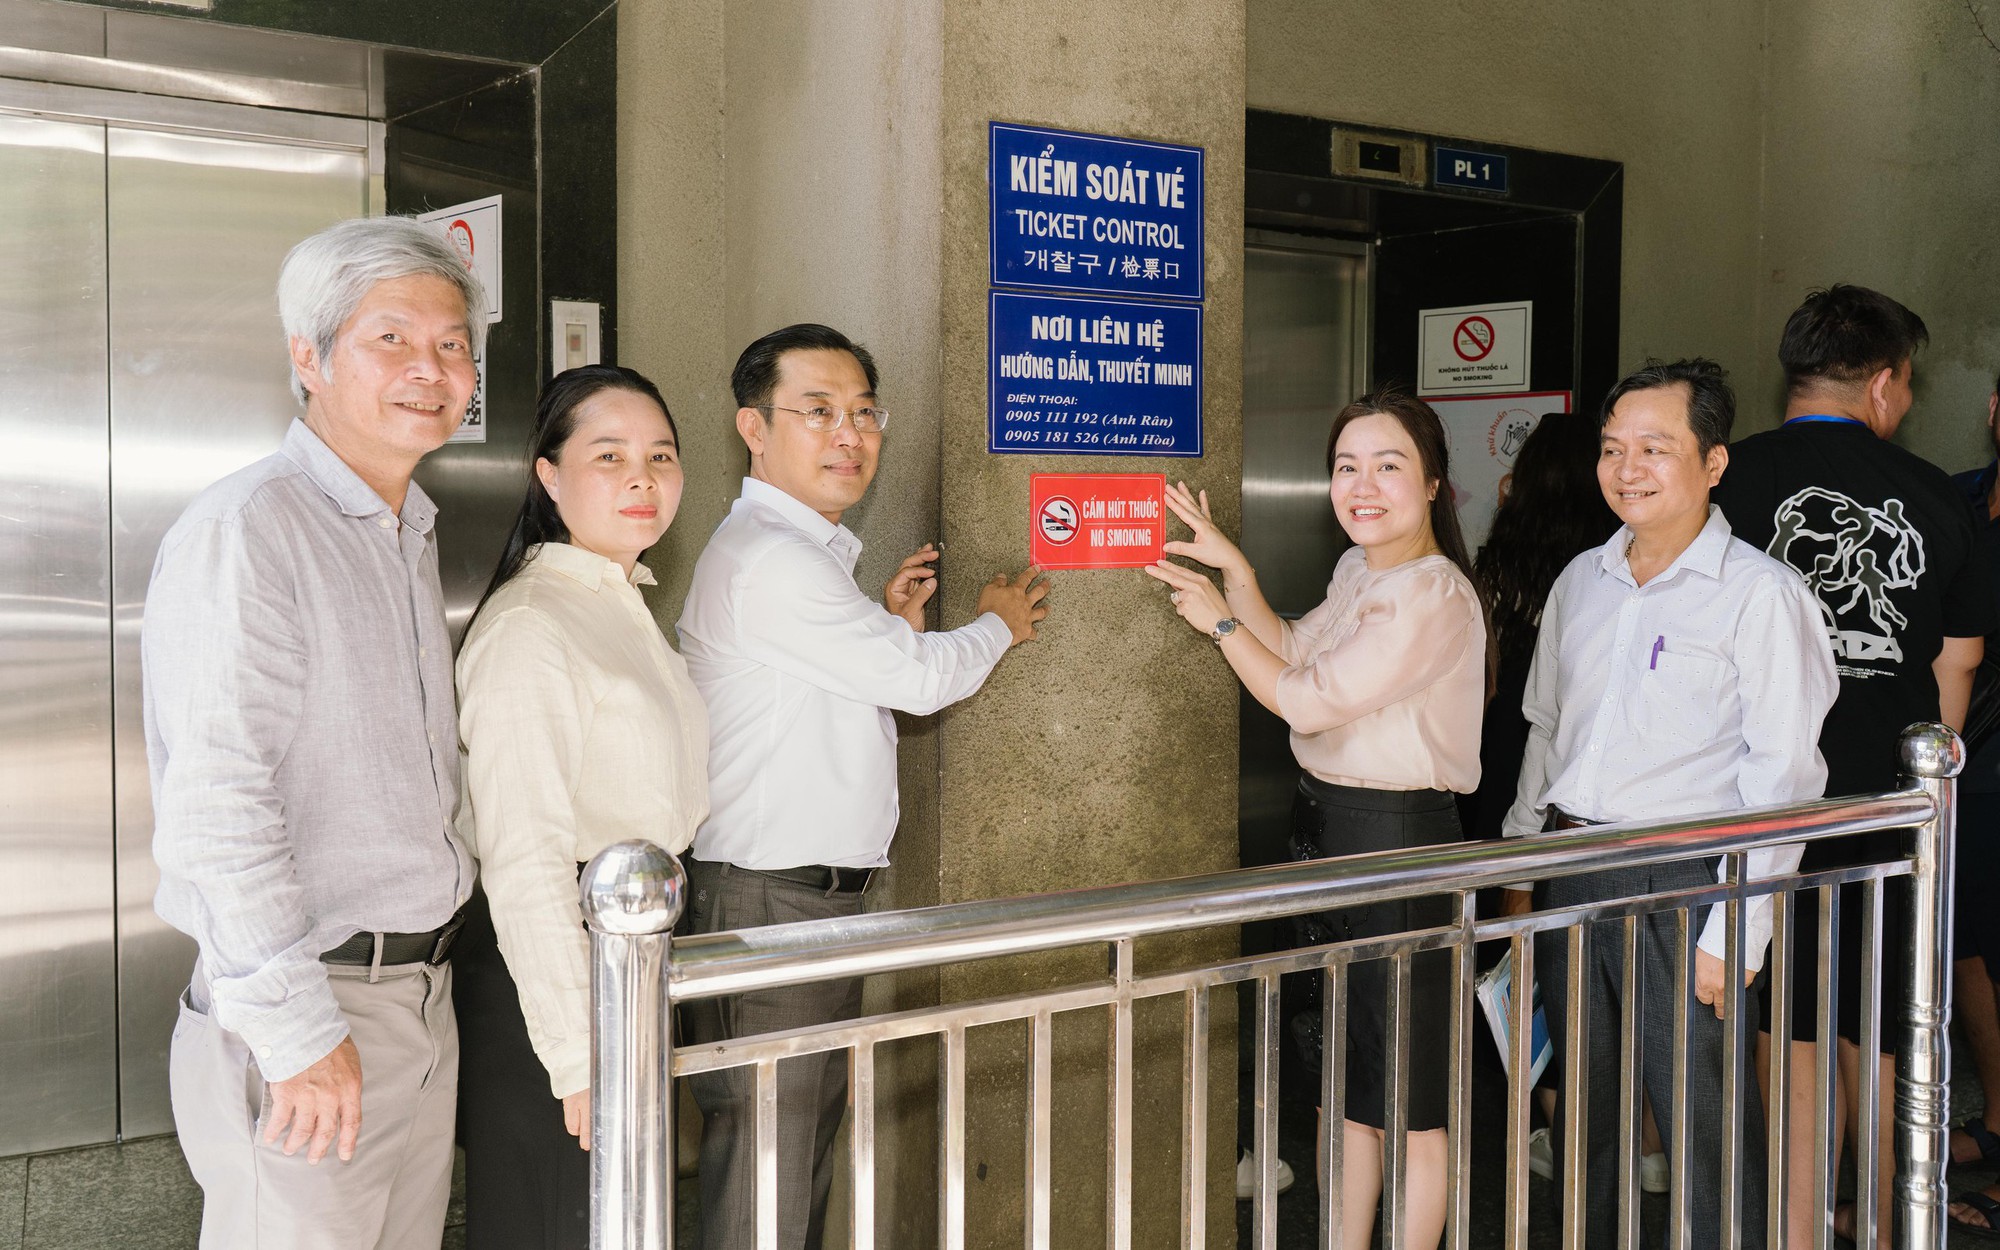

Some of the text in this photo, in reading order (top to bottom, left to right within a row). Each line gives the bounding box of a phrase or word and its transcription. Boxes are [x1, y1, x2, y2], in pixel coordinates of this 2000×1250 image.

[1011, 144, 1185, 209] KIỂM SOÁT VÉ
[1454, 160, 1490, 181] PL 1
[1015, 209, 1185, 250] TICKET CONTROL
[1024, 250, 1180, 280] 개찰구 / 检票口
[1031, 315, 1164, 352] NƠI LIÊN HỆ
[1000, 350, 1192, 386] HƯỚNG DẪN, THUYẾT MINH
[1438, 365, 1460, 374] KHÔNG
[1476, 363, 1499, 371] THUỐC
[1500, 362, 1509, 370] LÁ
[1463, 374, 1493, 382] SMOKING
[1007, 393, 1078, 406] ĐIỆN THOẠI:
[1005, 410, 1174, 429] 0905 111 192 (Anh Rân)
[1005, 430, 1176, 447] 0905 181 526 (Anh Hòa)
[1082, 494, 1159, 519] CẤM HÚT THUỐC
[1090, 528, 1152, 547] NO SMOKING
